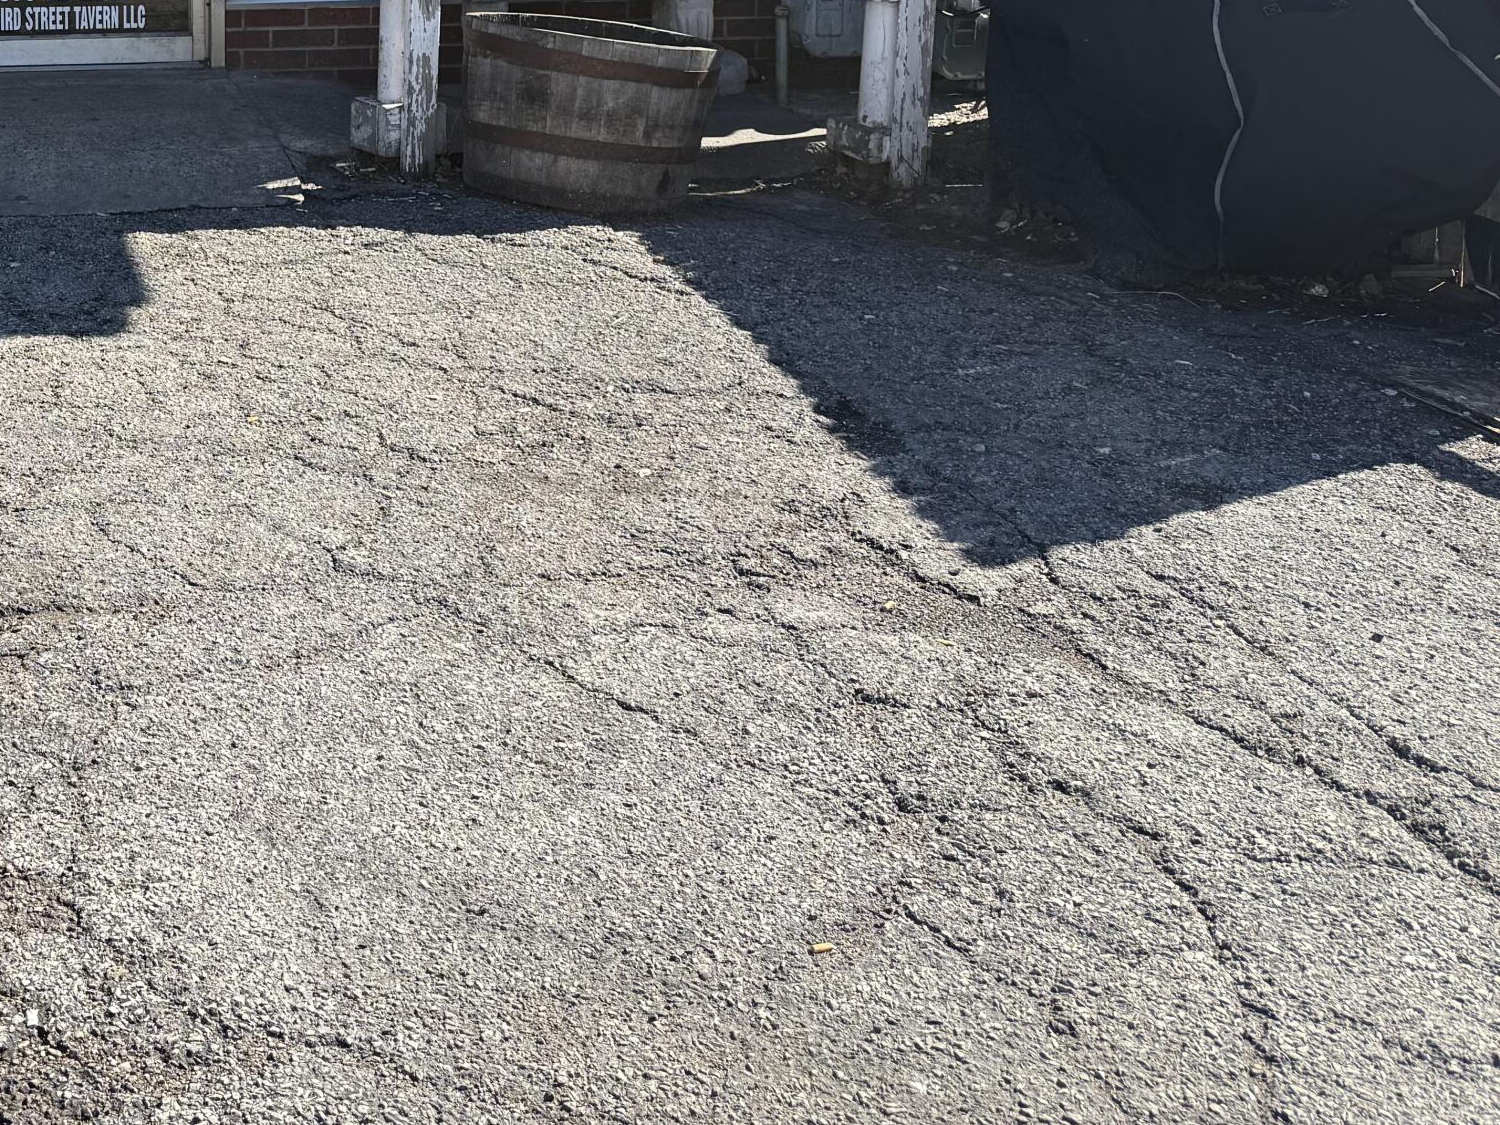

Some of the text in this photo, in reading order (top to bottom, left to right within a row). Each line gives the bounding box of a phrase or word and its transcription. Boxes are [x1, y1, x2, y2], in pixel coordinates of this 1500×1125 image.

[25, 6, 70, 30] STREET
[73, 6, 119, 29] TAVERN
[123, 4, 146, 28] LLC
